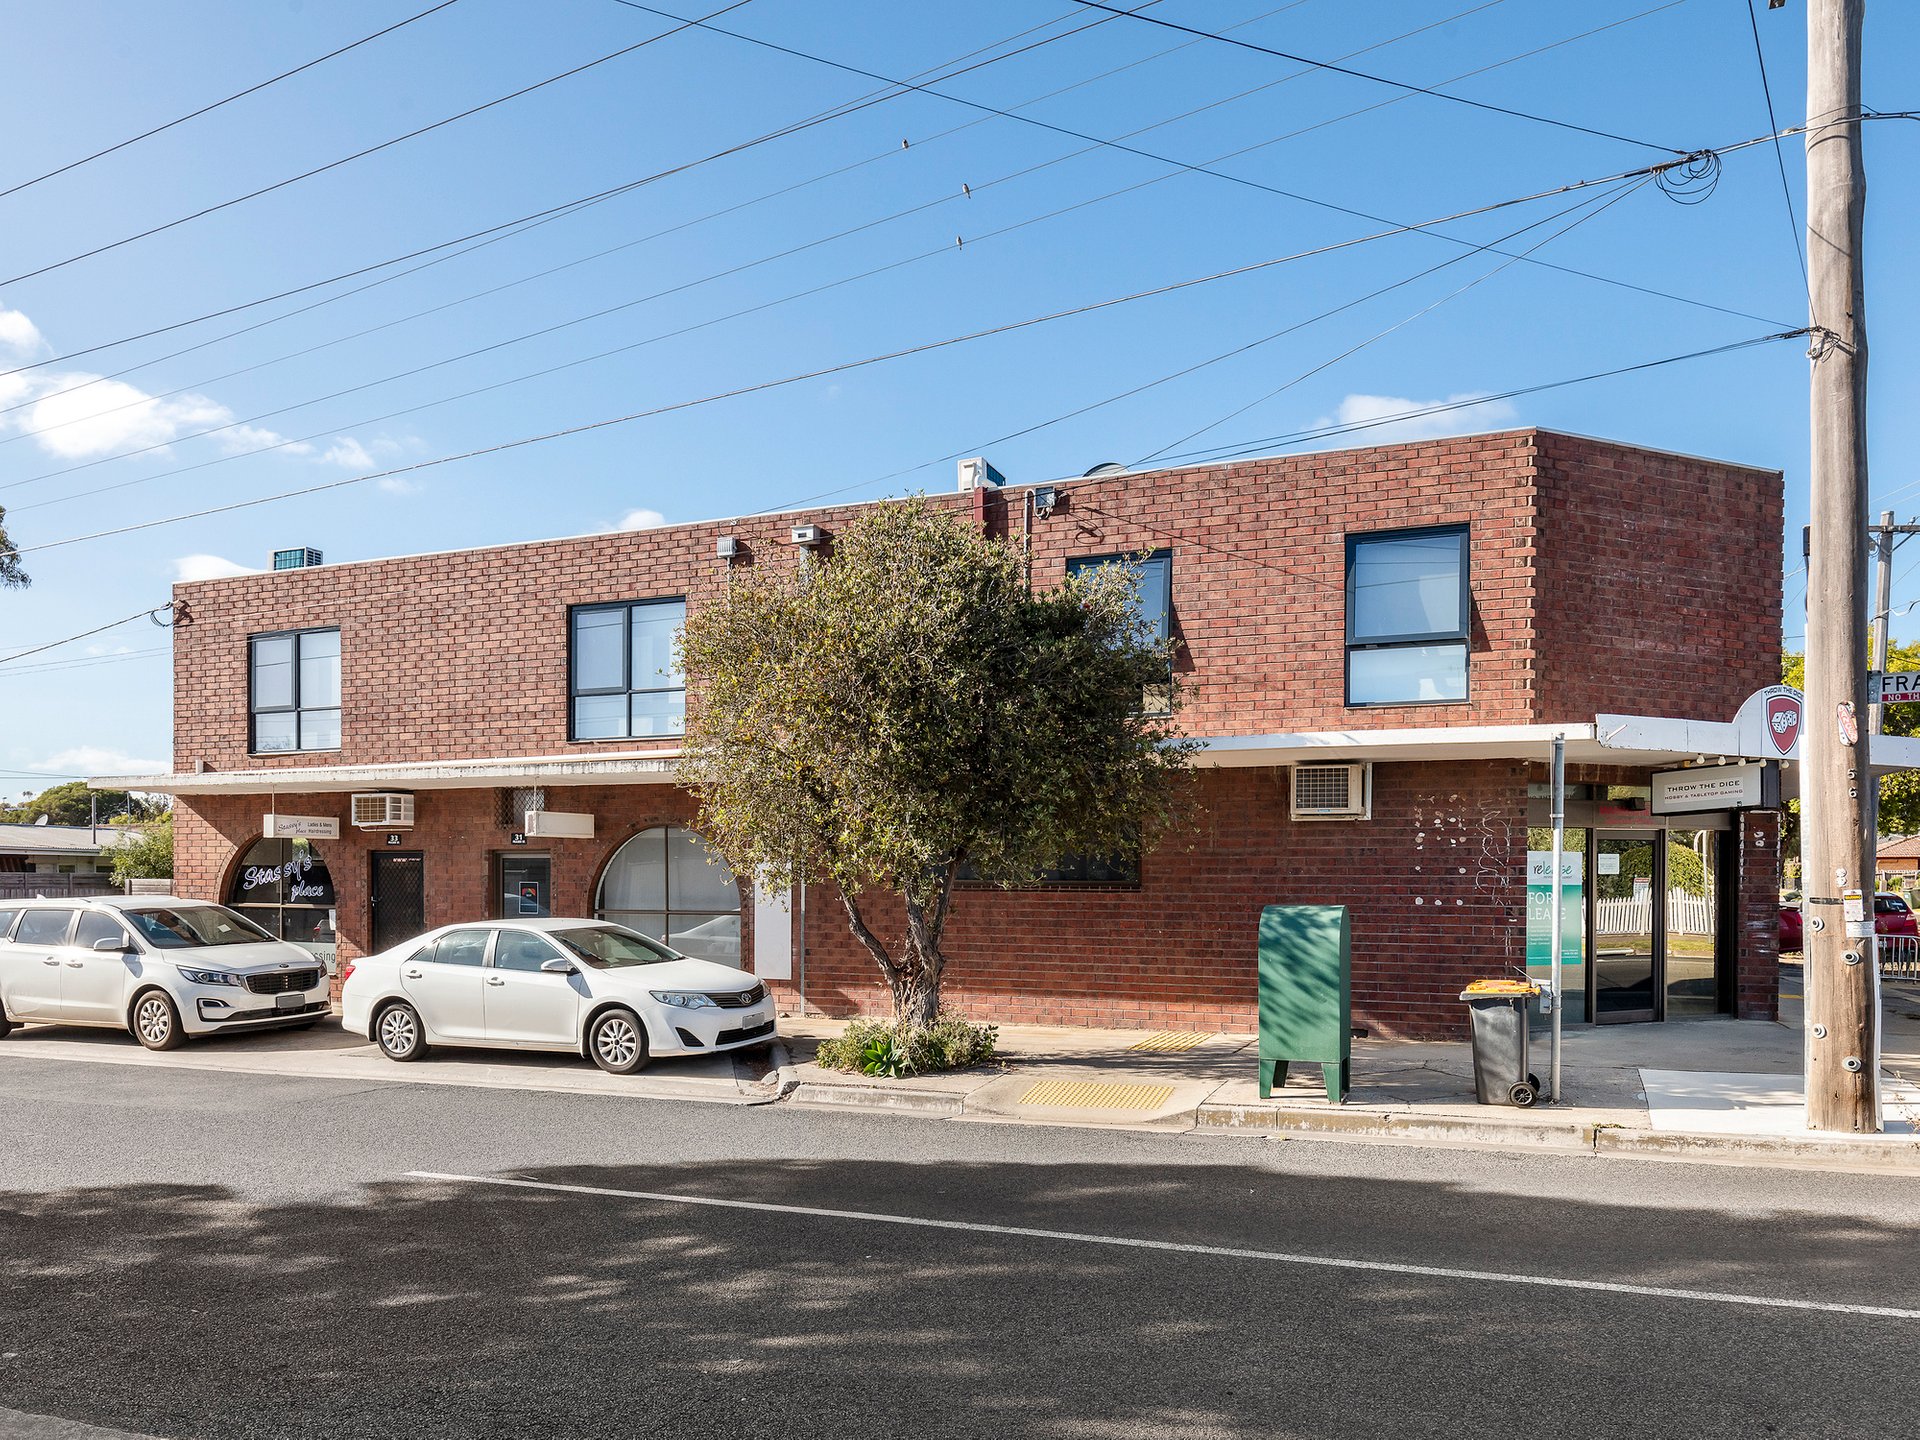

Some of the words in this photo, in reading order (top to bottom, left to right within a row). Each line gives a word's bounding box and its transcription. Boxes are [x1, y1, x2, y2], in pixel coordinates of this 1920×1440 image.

[1719, 780, 1740, 788] DICE
[1720, 788, 1743, 796] GAMING
[278, 820, 302, 832] Stassy's
[243, 849, 313, 890] Stassy's
[290, 880, 324, 902] place
[1528, 891, 1553, 905] FOR
[1528, 907, 1567, 920] LEAE
